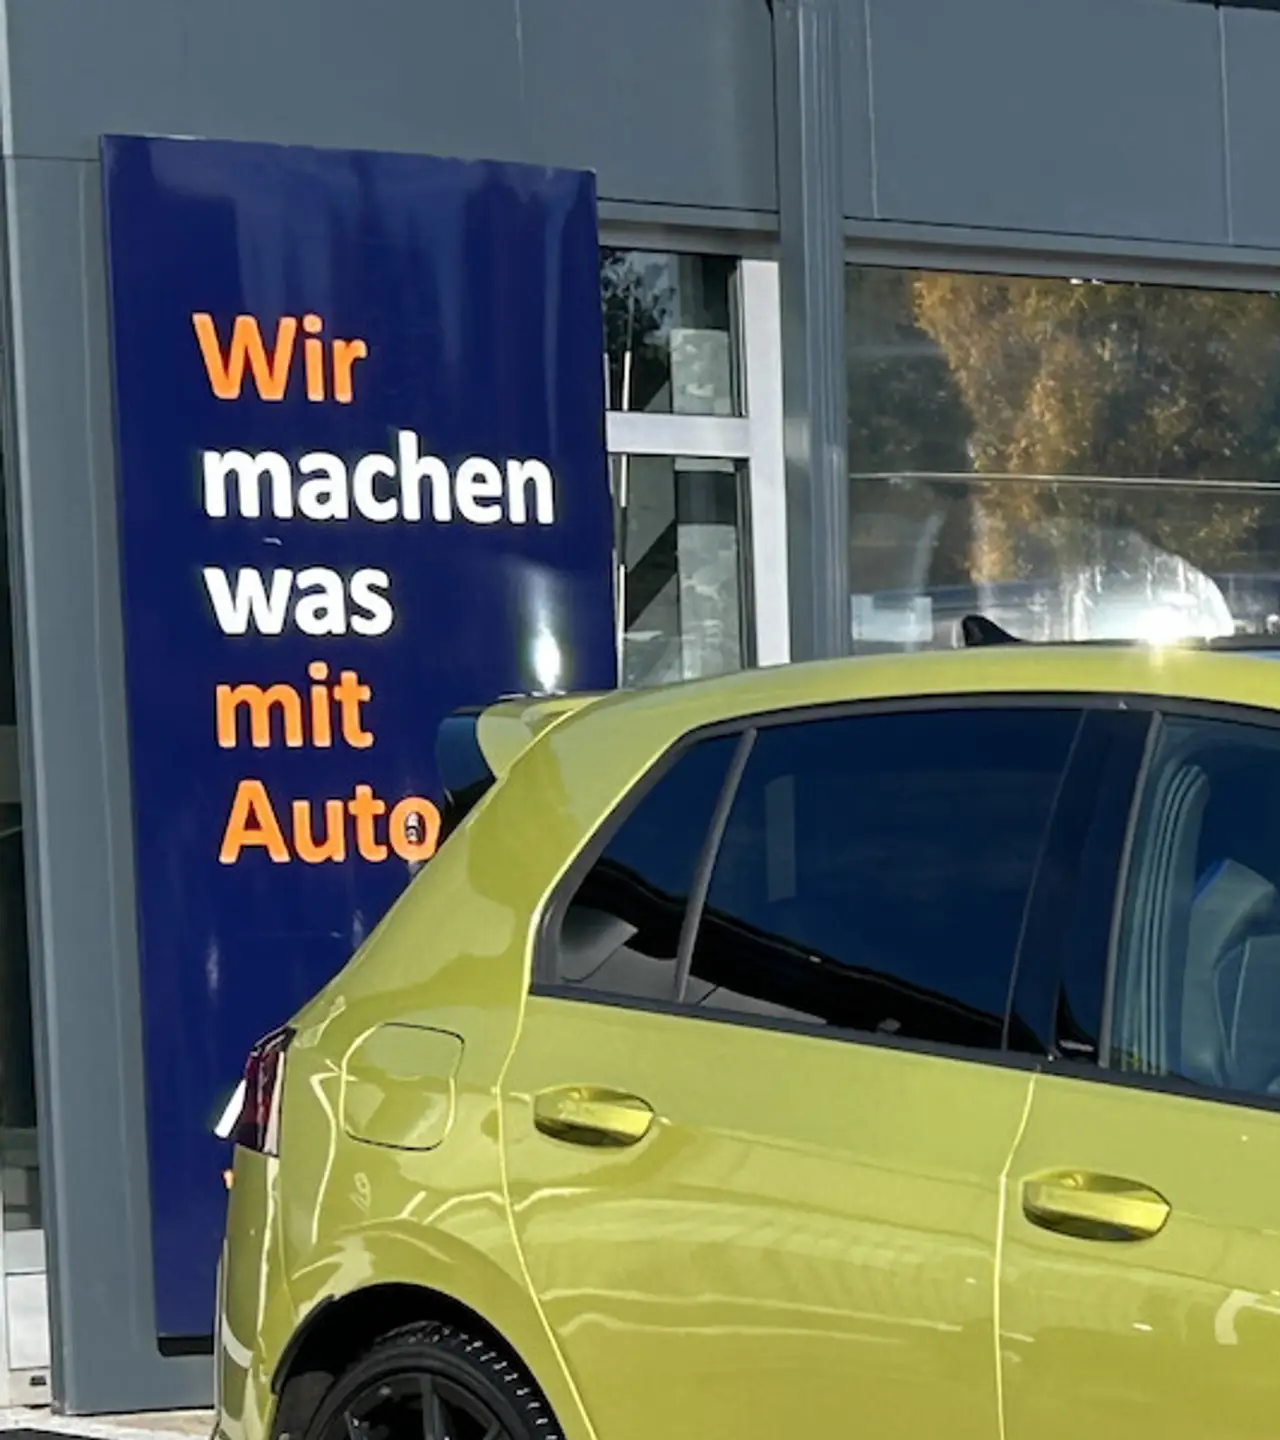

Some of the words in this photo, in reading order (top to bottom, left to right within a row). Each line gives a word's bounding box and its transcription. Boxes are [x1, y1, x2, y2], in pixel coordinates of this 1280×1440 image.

[192, 312, 368, 404] Wir
[203, 429, 555, 525] machen
[203, 565, 394, 636] was
[215, 660, 374, 749] mit
